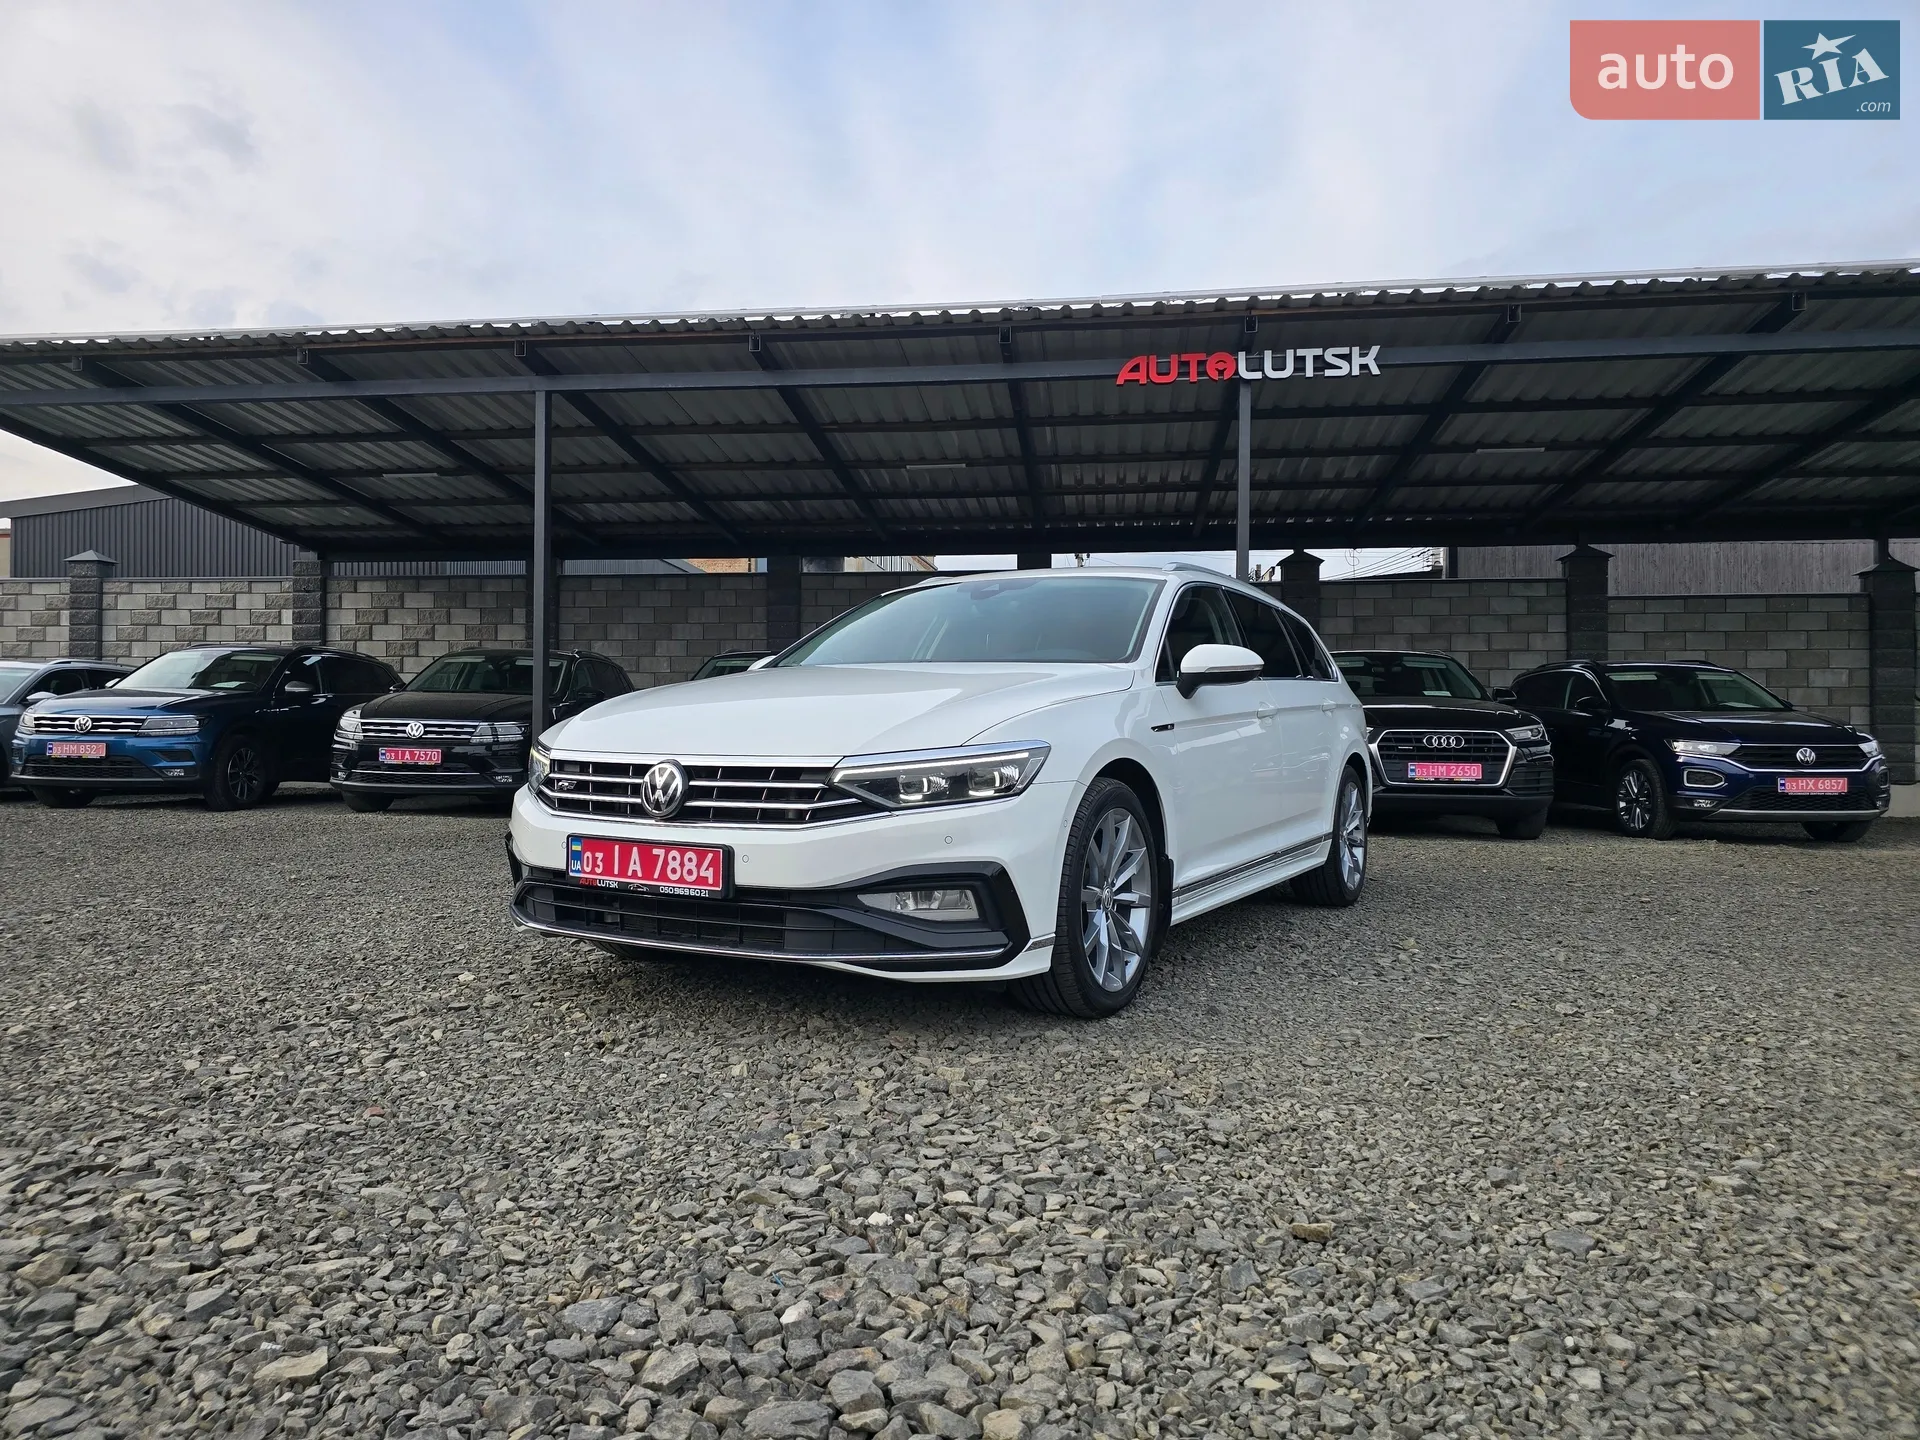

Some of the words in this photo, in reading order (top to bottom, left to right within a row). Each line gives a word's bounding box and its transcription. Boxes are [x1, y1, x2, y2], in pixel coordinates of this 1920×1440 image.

[413, 750, 438, 761] 7570
[1429, 765, 1447, 776] HM
[1449, 765, 1478, 777] 2650
[1798, 779, 1815, 790] HX
[1817, 779, 1844, 790] 6857
[571, 859, 582, 871] UA
[583, 851, 604, 874] 03
[652, 848, 714, 885] 7884
